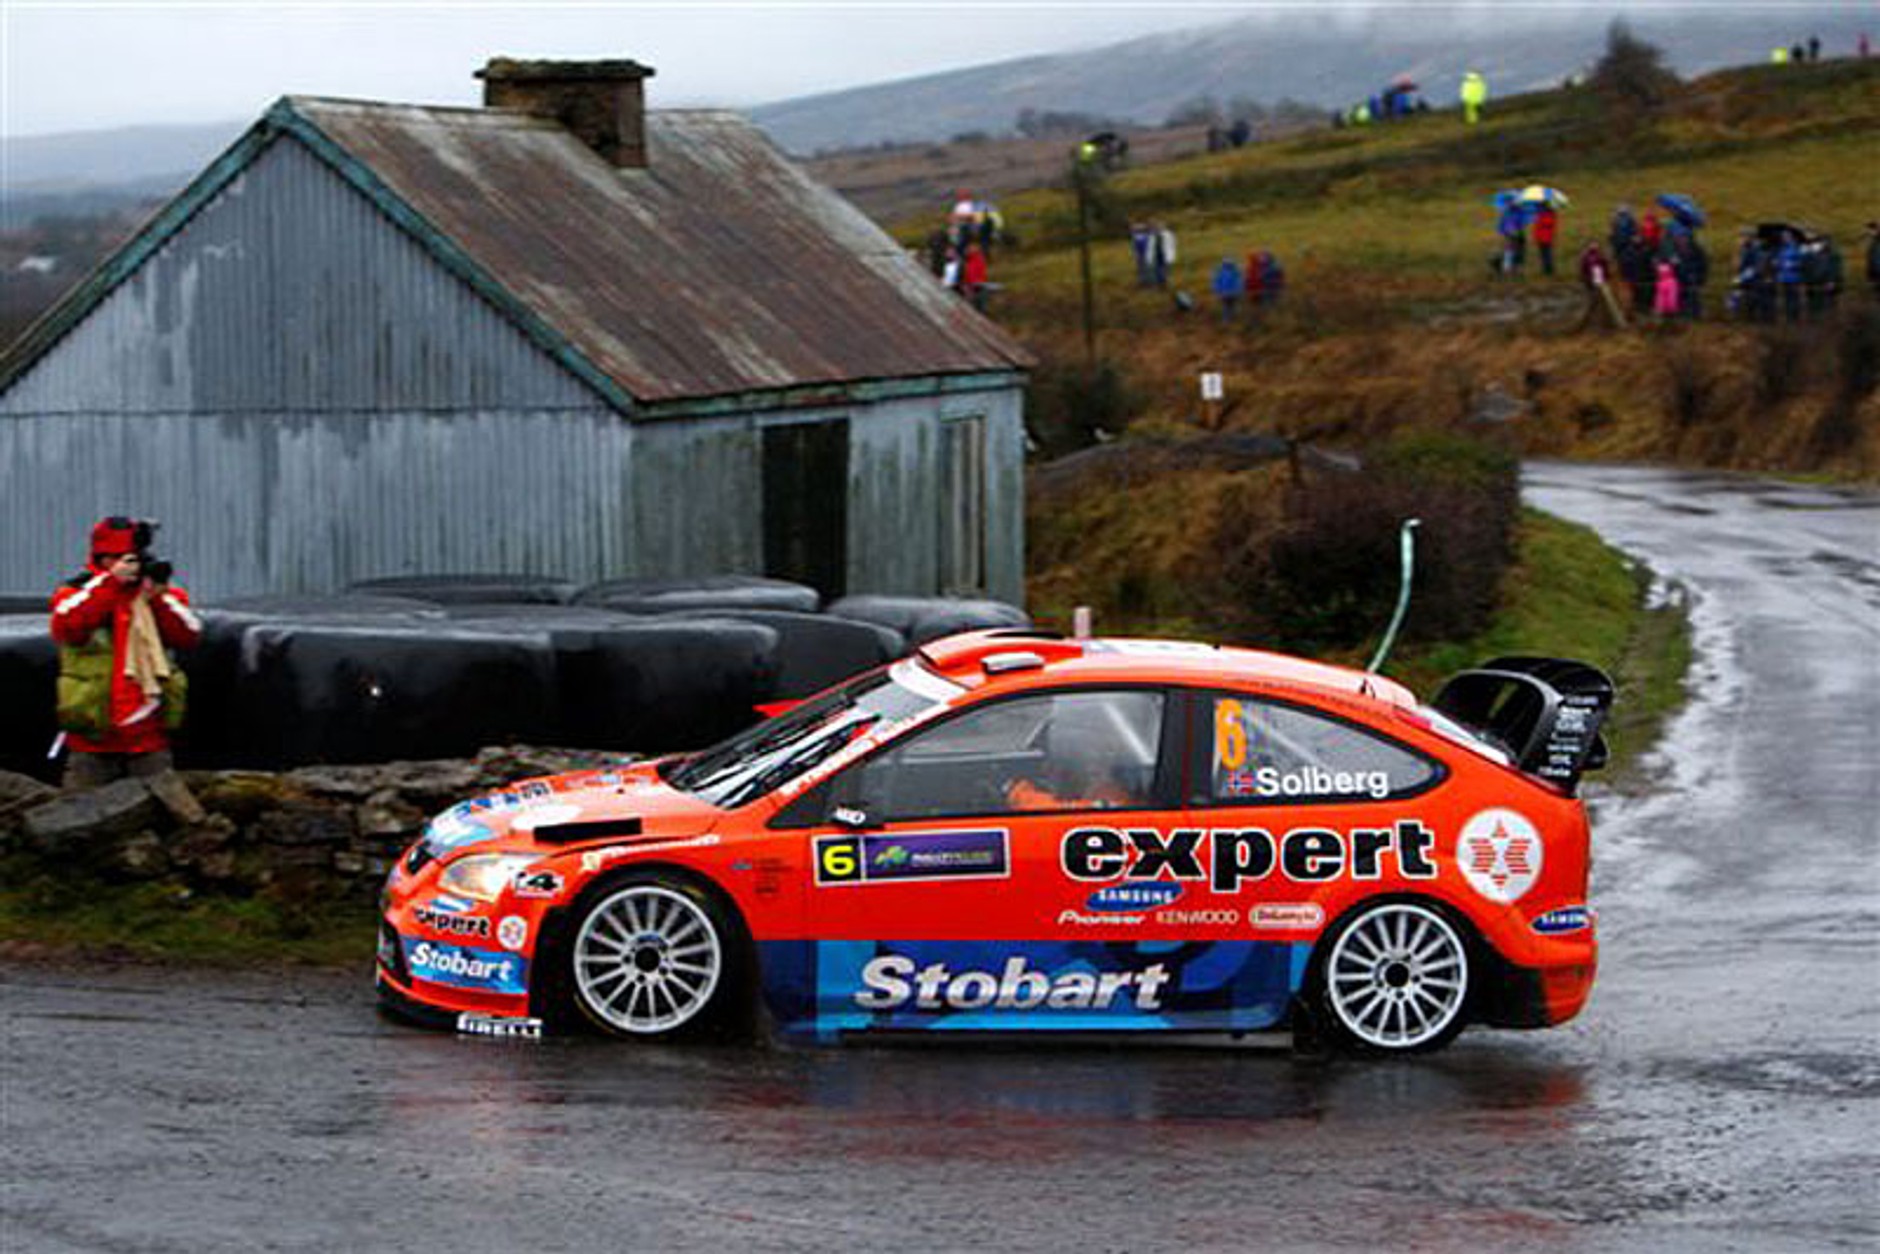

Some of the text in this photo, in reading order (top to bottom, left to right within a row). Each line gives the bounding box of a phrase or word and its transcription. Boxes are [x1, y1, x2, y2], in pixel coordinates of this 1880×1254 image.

[1216, 698, 1247, 770] 6
[1256, 765, 1389, 798] Solberg
[823, 845, 856, 876] 6
[1062, 818, 1437, 893] expert
[415, 907, 492, 938] expert
[410, 942, 513, 981] Stobart
[854, 955, 1170, 1010] Stobart
